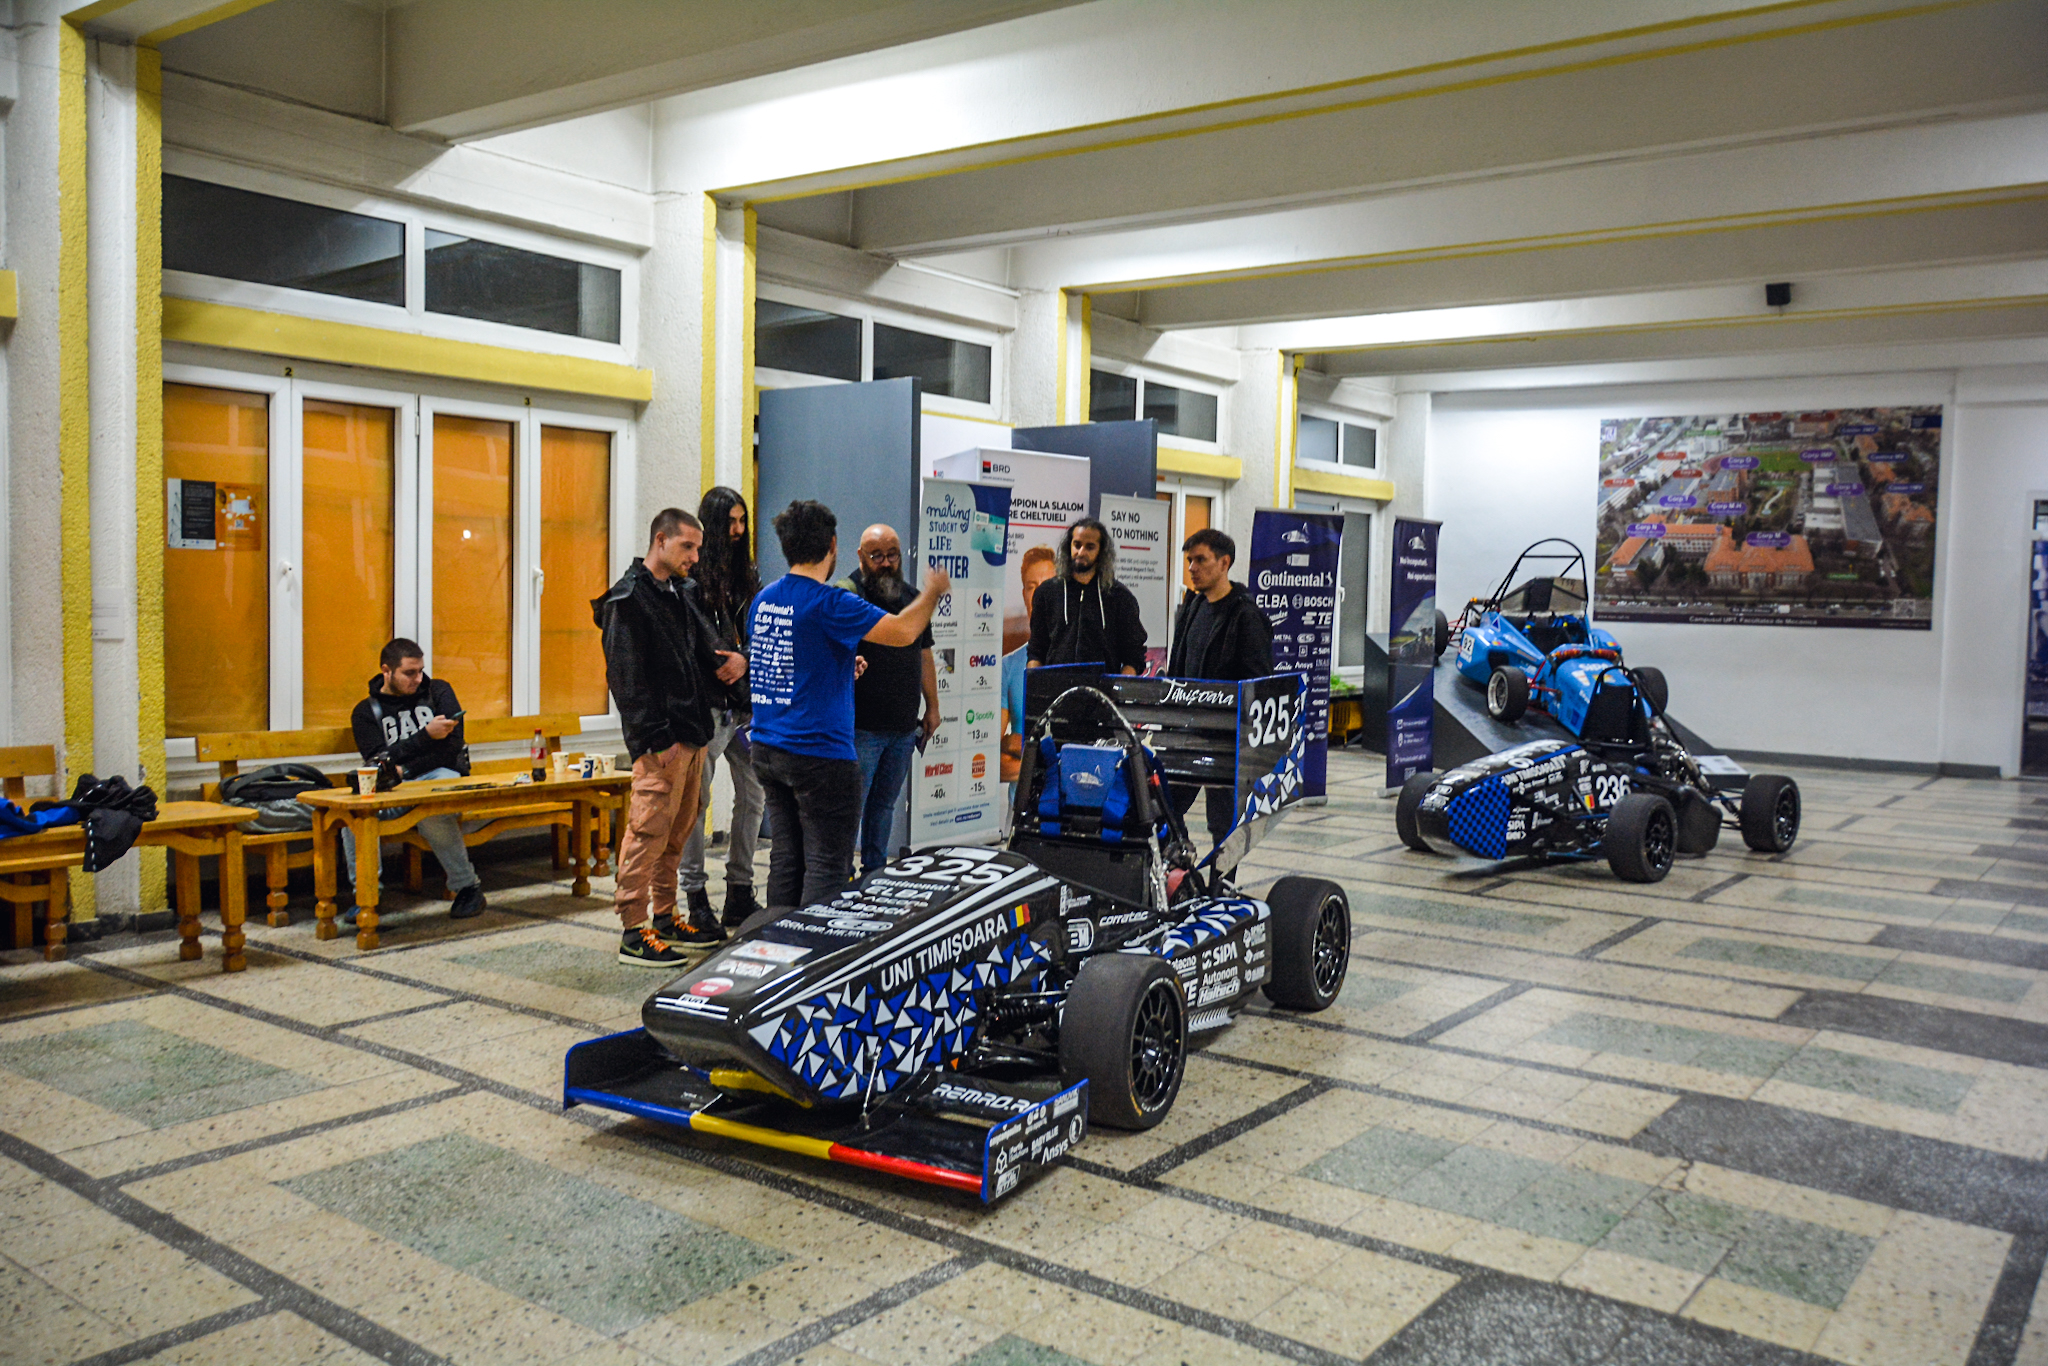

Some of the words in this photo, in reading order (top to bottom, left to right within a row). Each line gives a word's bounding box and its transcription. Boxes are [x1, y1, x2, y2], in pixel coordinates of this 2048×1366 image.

[285, 367, 292, 377] 2
[992, 463, 1011, 474] BRD
[1039, 500, 1050, 509] LA
[1052, 501, 1084, 512] SLALOM
[1020, 511, 1066, 522] CHELTUIELI
[1111, 510, 1127, 522] SAY
[1128, 512, 1140, 524] NO
[929, 521, 957, 533] STUDENT
[1111, 527, 1123, 539] TO
[1124, 529, 1159, 542] NOTHING
[1257, 569, 1325, 591] Continental
[1255, 594, 1289, 609] ELBA
[1303, 596, 1334, 608] BOSCH
[1317, 611, 1333, 625] TE
[1294, 661, 1314, 670] Ansys
[975, 710, 995, 720] Spotify
[1248, 694, 1290, 748] 325
[1595, 774, 1632, 807] 236
[883, 855, 1016, 885] 325
[864, 885, 934, 901] ELBA
[850, 902, 911, 916] BOSCH
[1099, 910, 1149, 927] corratec
[880, 955, 914, 993] UNI
[1202, 965, 1238, 987] Autonom
[1199, 978, 1240, 1006] Haltech
[1041, 1137, 1069, 1166] Ansys
